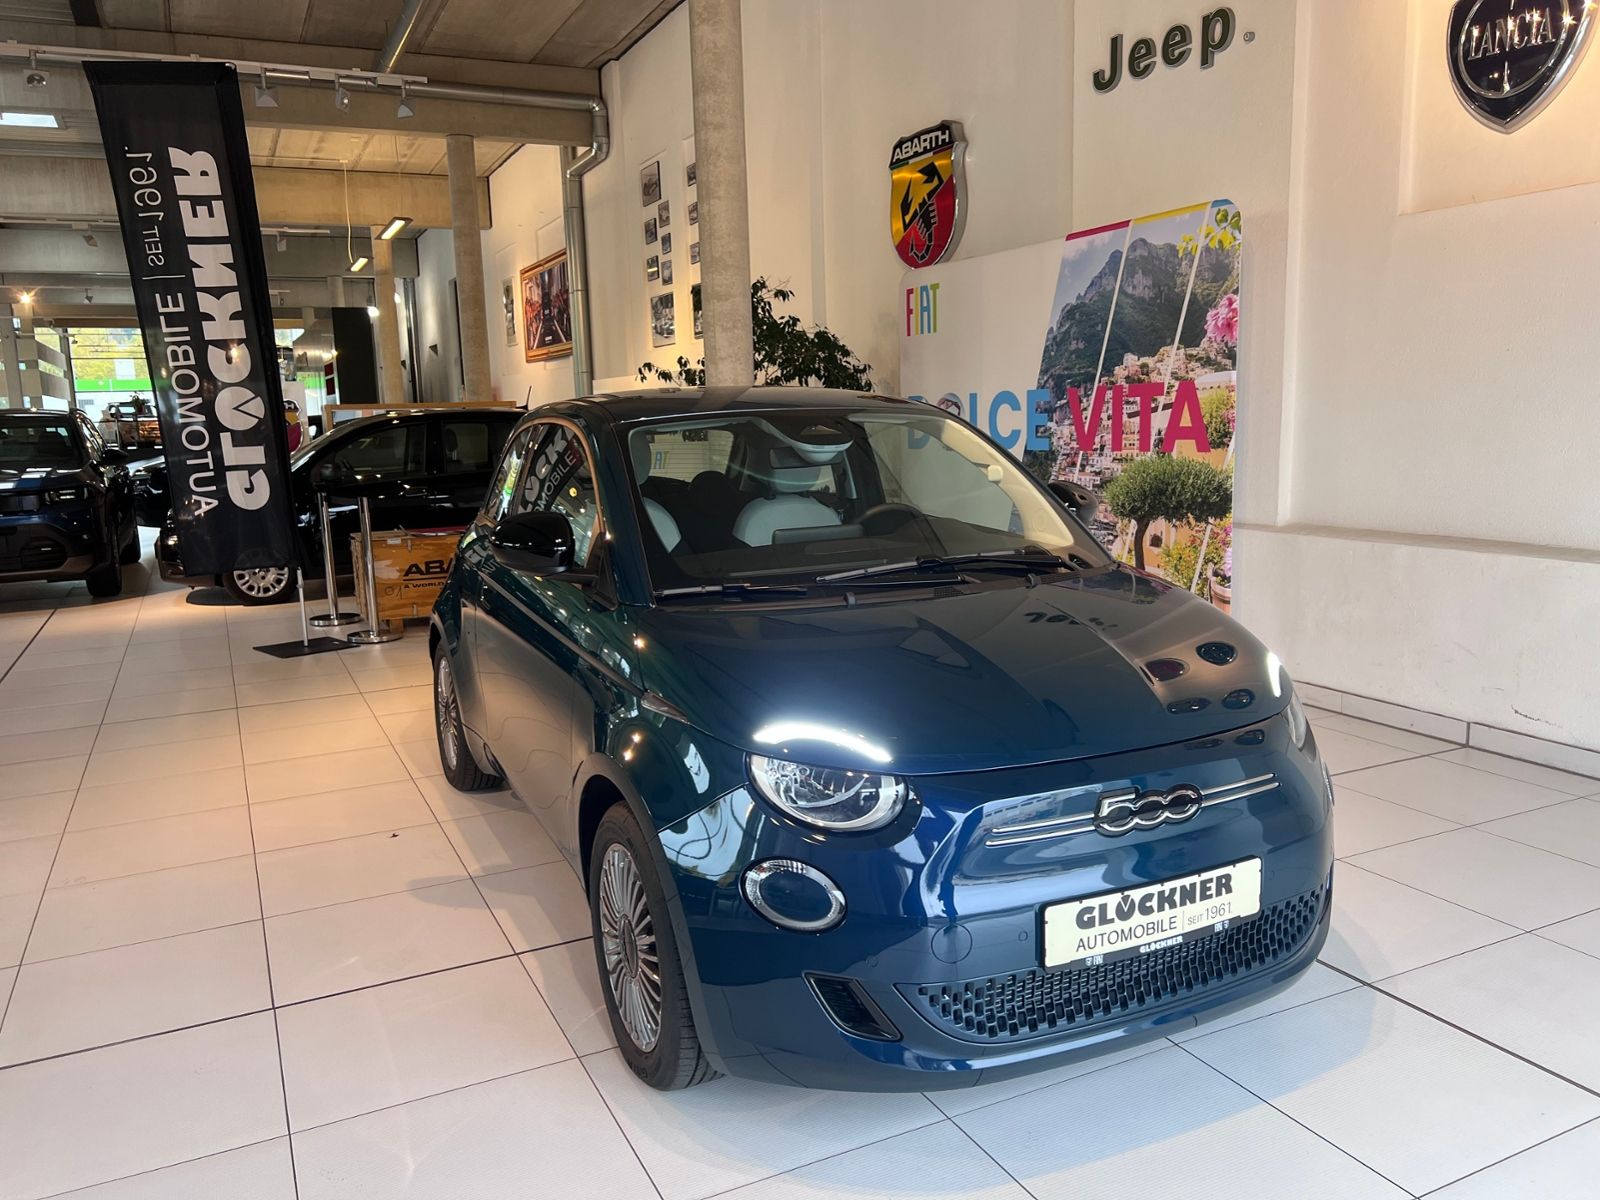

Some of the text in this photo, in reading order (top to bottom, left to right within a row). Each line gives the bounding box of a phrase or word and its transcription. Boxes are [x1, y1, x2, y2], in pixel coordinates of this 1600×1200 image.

[1092, 6, 1237, 93] Jeep
[1467, 8, 1556, 60] LANCIA
[892, 130, 950, 163] ABARTH
[905, 282, 940, 337] FIAT
[1066, 379, 1212, 454] VITA
[1096, 785, 1202, 837] 500
[1076, 915, 1178, 953] AUTOMOBILE
[1187, 913, 1203, 926] SEIT
